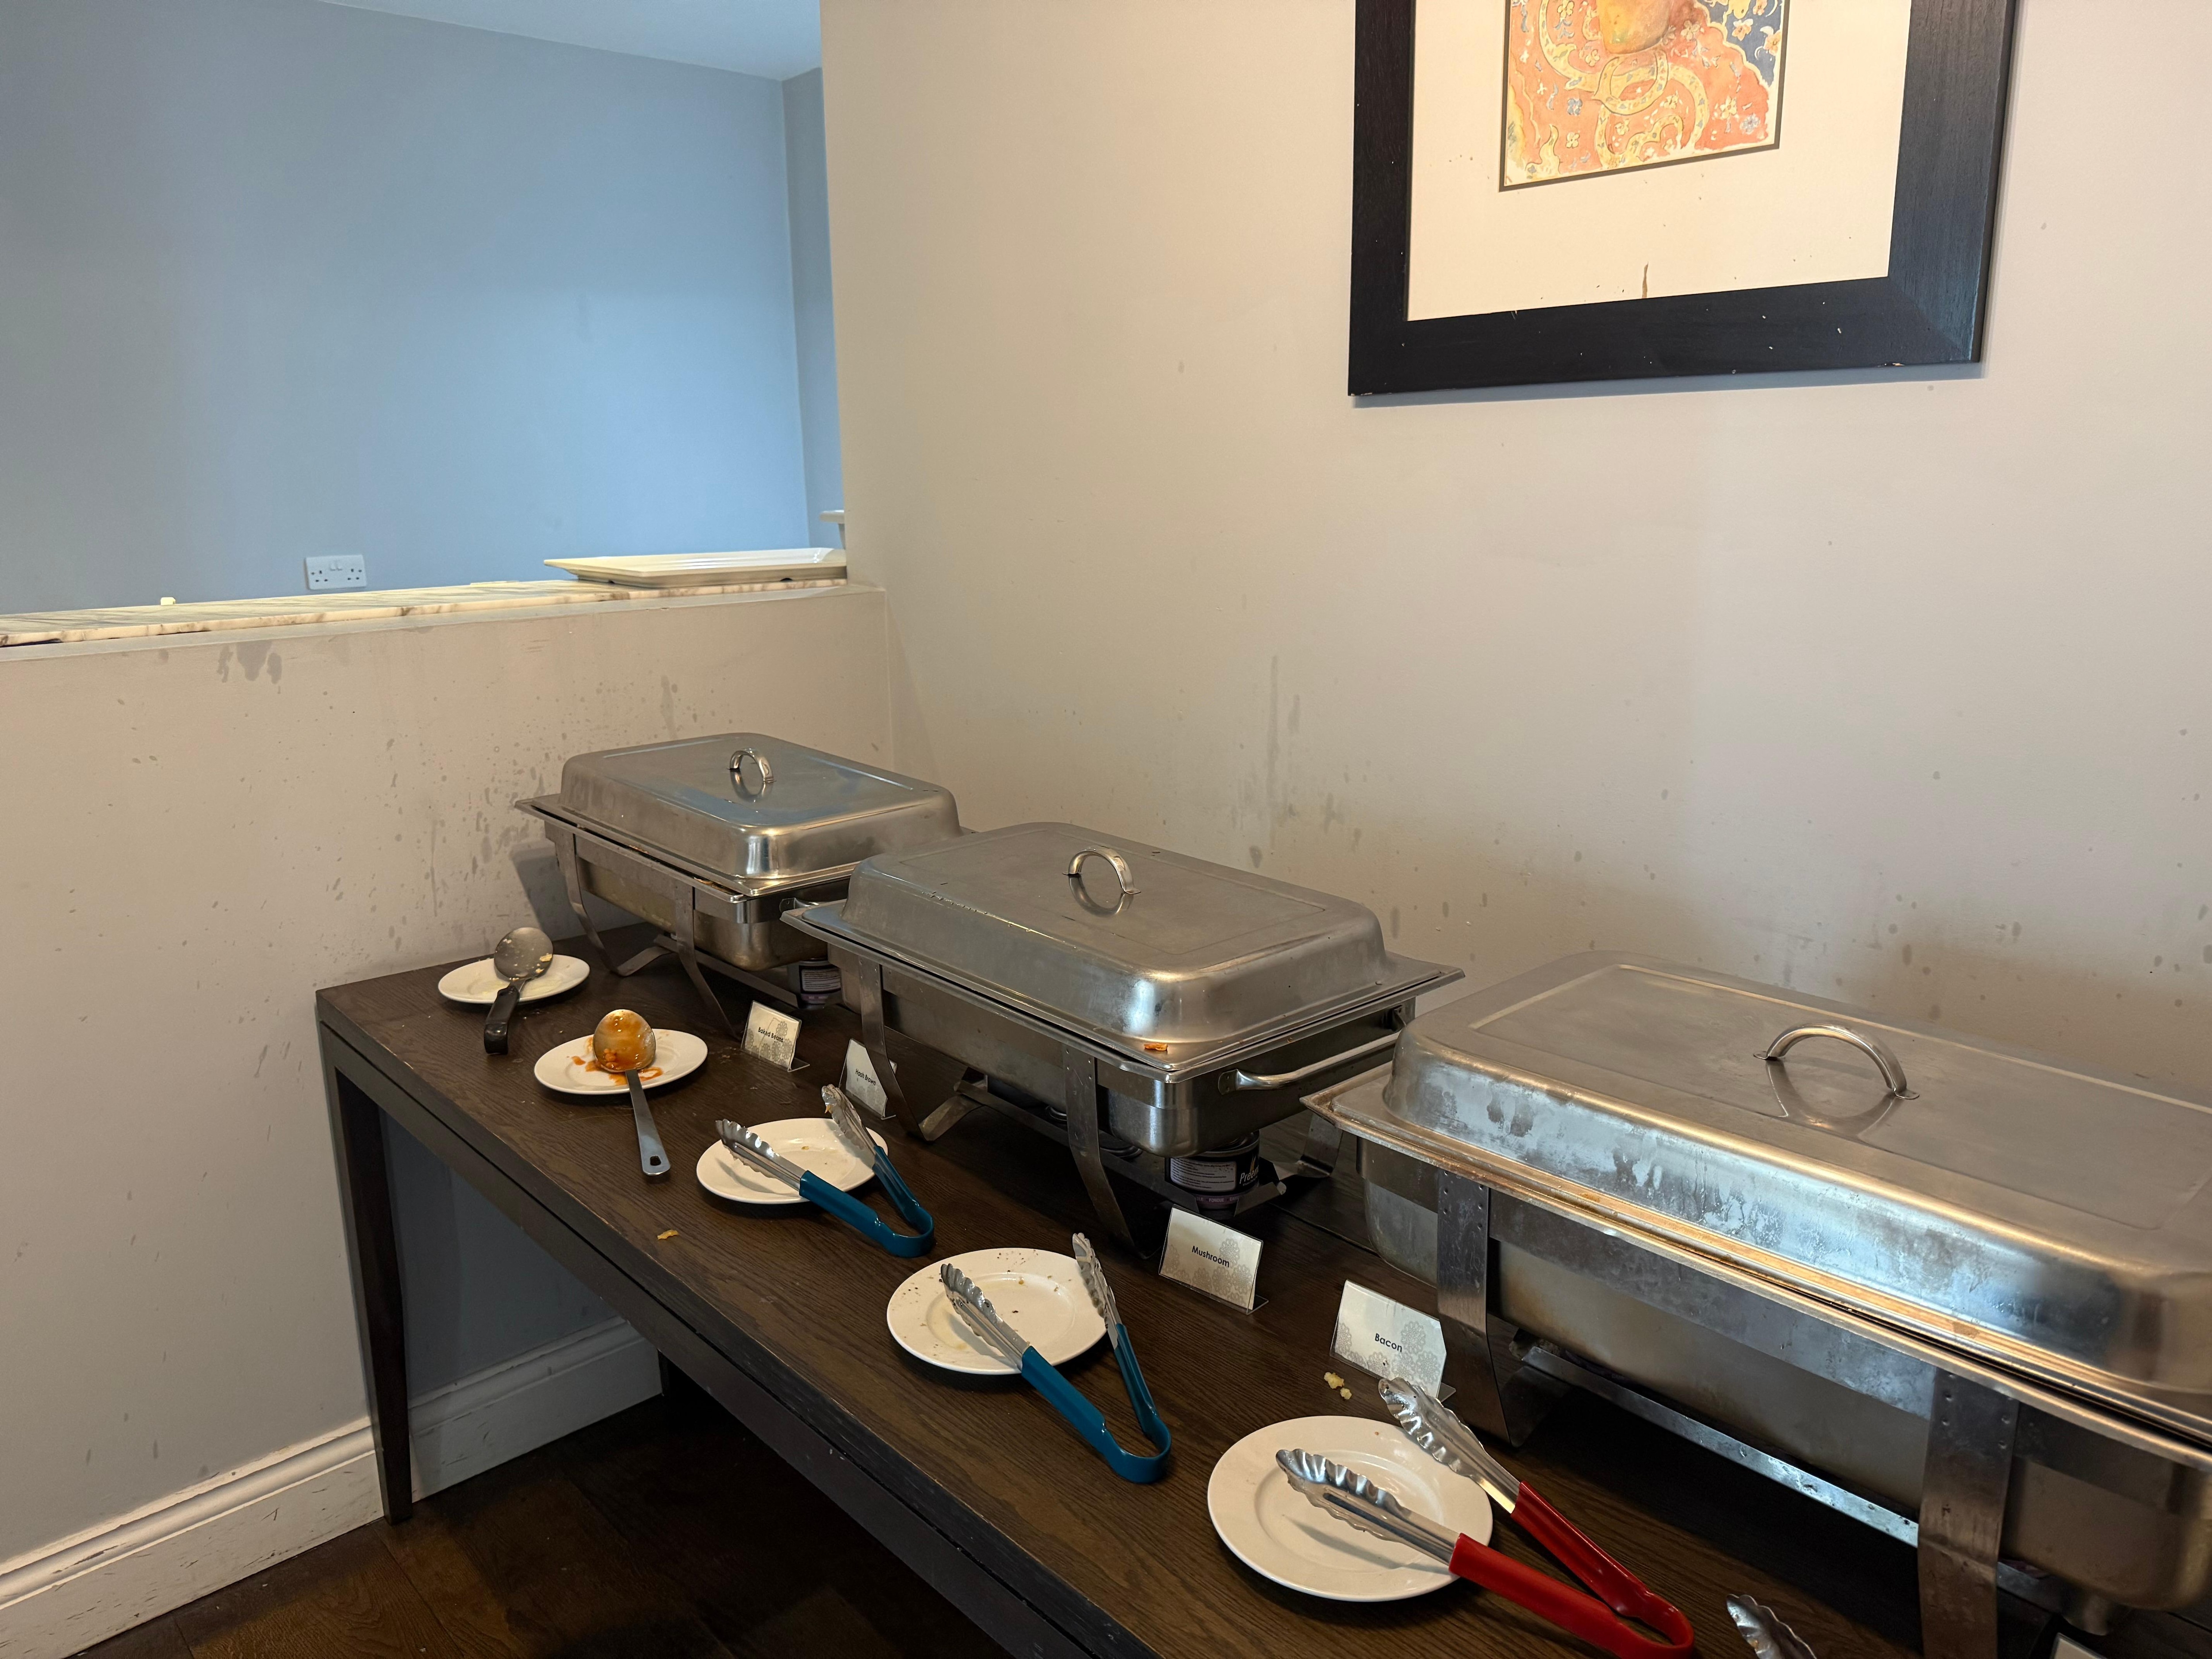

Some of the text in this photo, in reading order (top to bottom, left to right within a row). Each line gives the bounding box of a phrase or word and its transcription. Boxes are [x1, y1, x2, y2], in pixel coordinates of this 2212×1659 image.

[758, 1026, 783, 1043] Baked Beans
[855, 1068, 876, 1086] Hash Brown
[1192, 1245, 1229, 1267] Mushroom
[1375, 1333, 1402, 1352] Bacon
